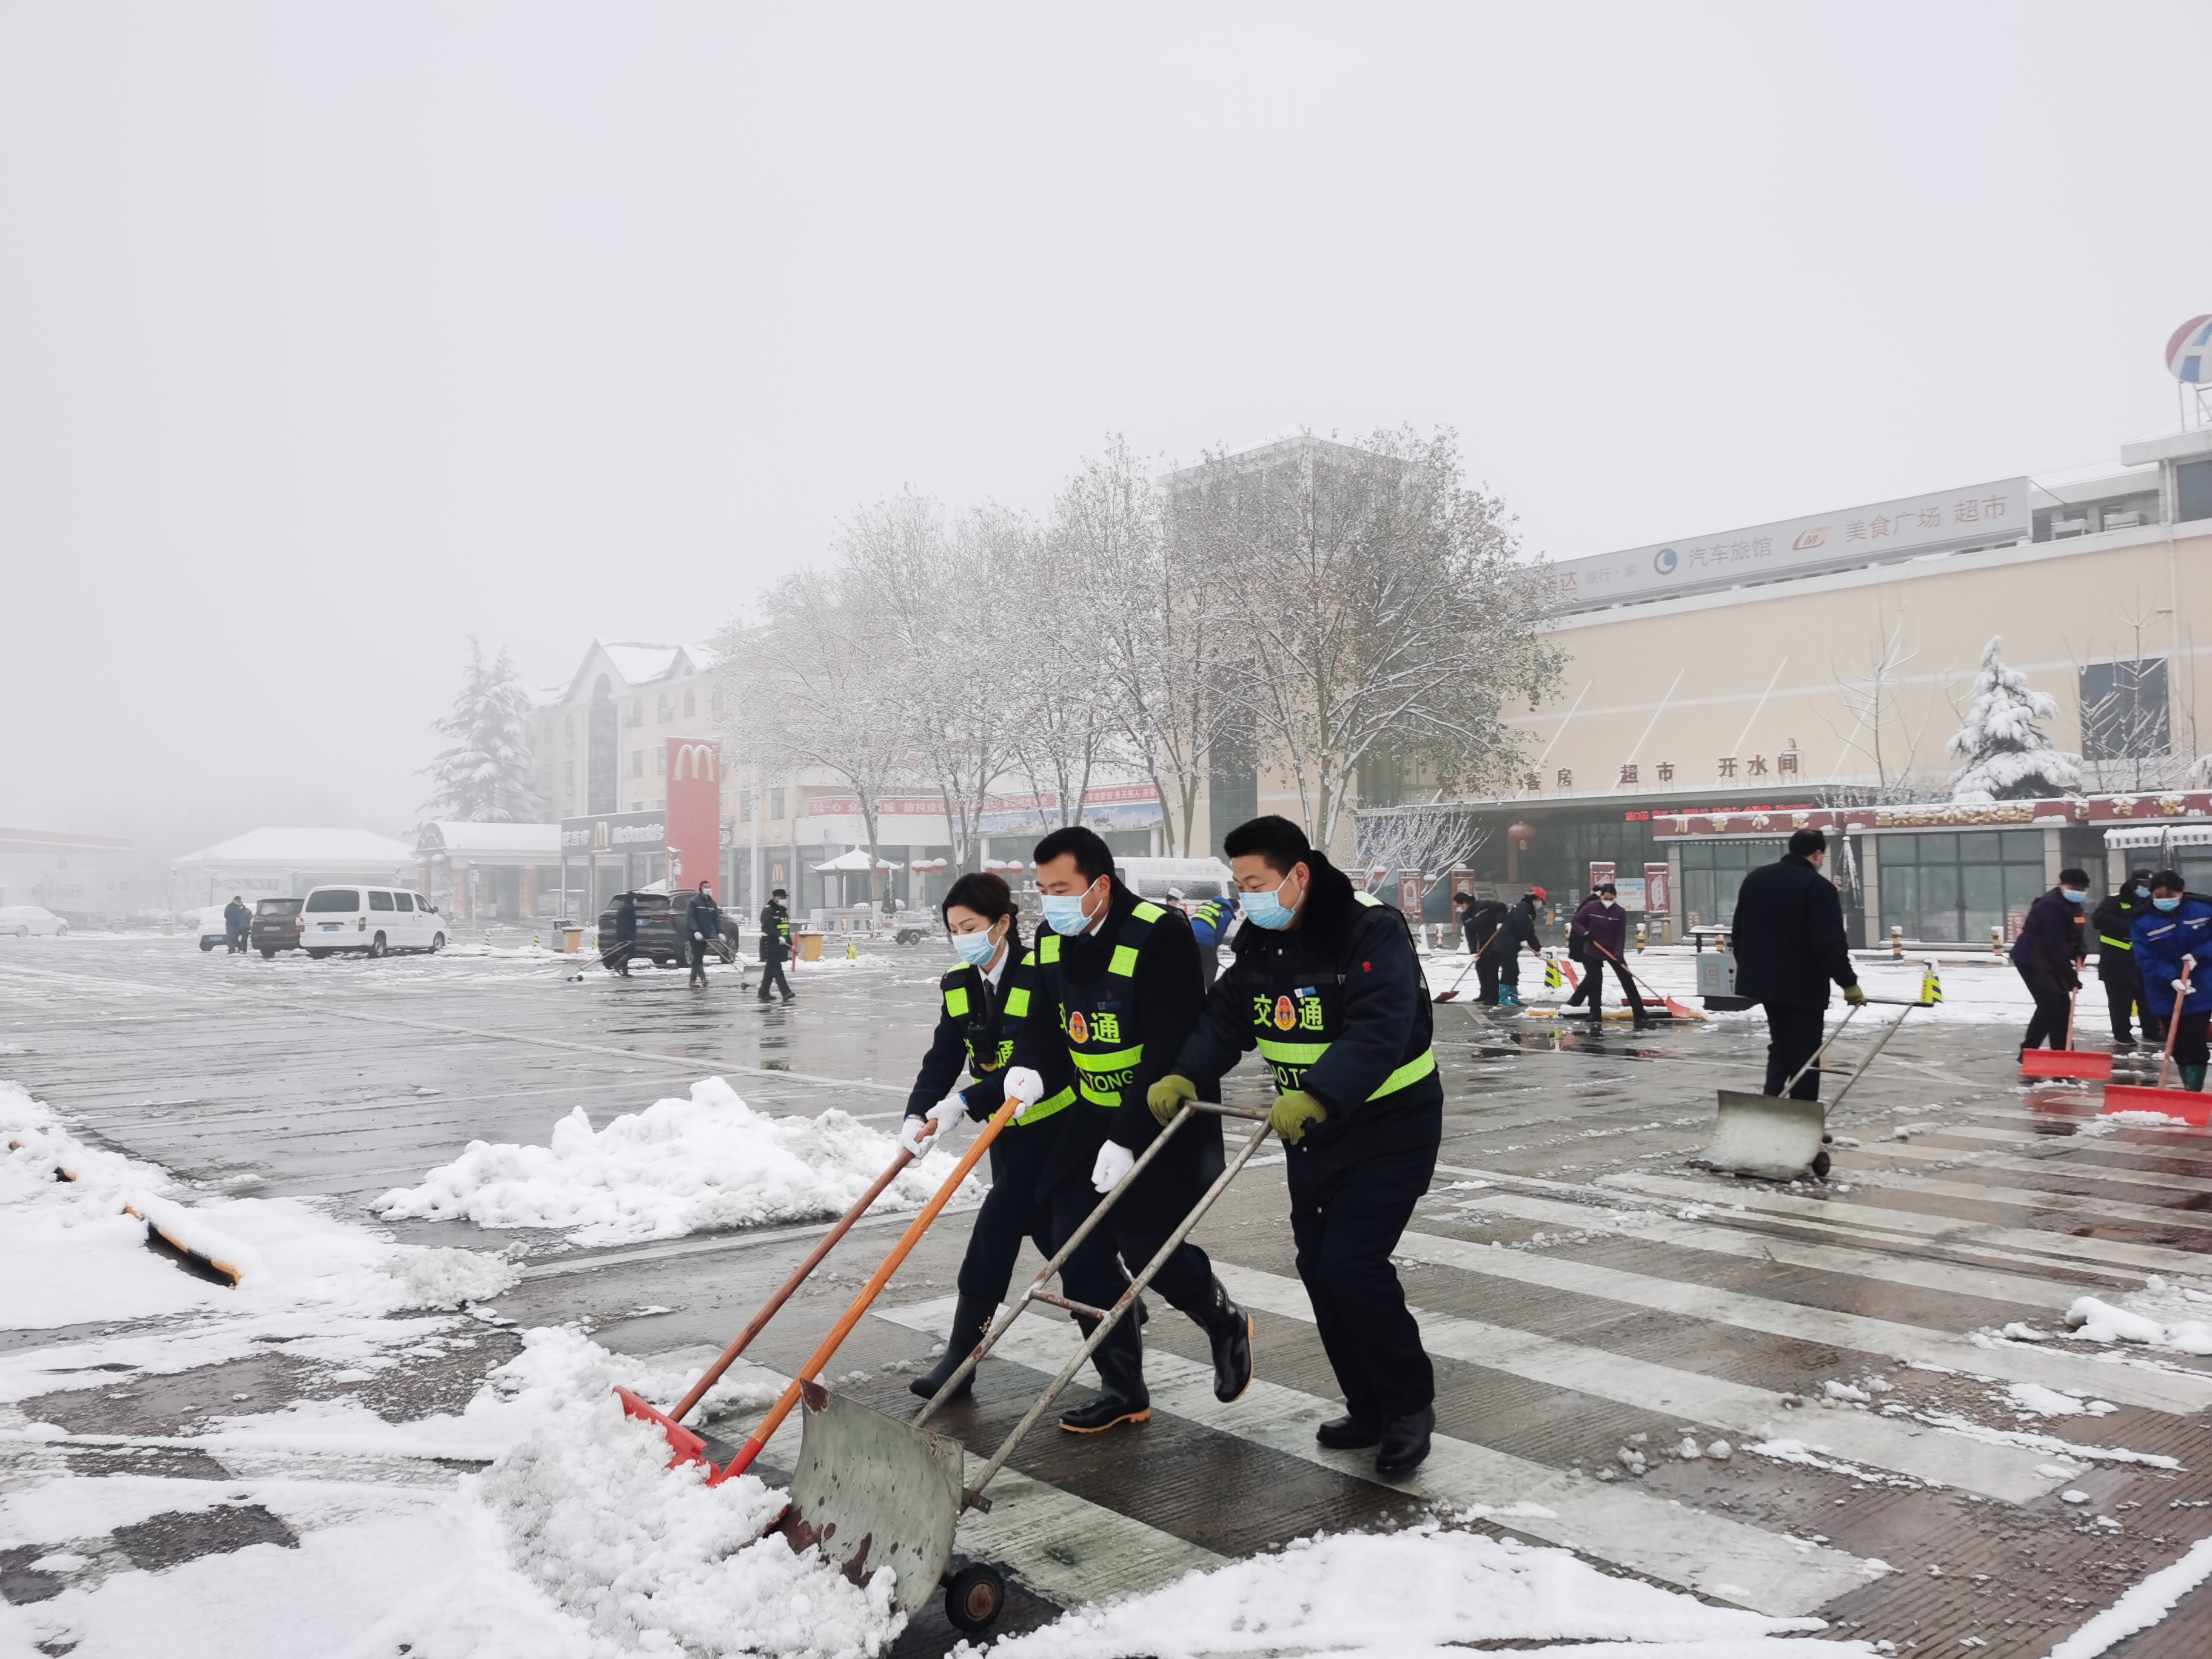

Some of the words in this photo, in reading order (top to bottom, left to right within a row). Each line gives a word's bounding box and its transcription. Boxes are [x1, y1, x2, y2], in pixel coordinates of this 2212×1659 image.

[1845, 506, 1940, 543] 美食广场
[1954, 494, 2008, 525] 超市
[1688, 537, 1772, 568] 汽车旅馆
[1619, 762, 1675, 783] 超市
[1717, 753, 1798, 777] 开水间
[1253, 993, 1324, 1031] 交通
